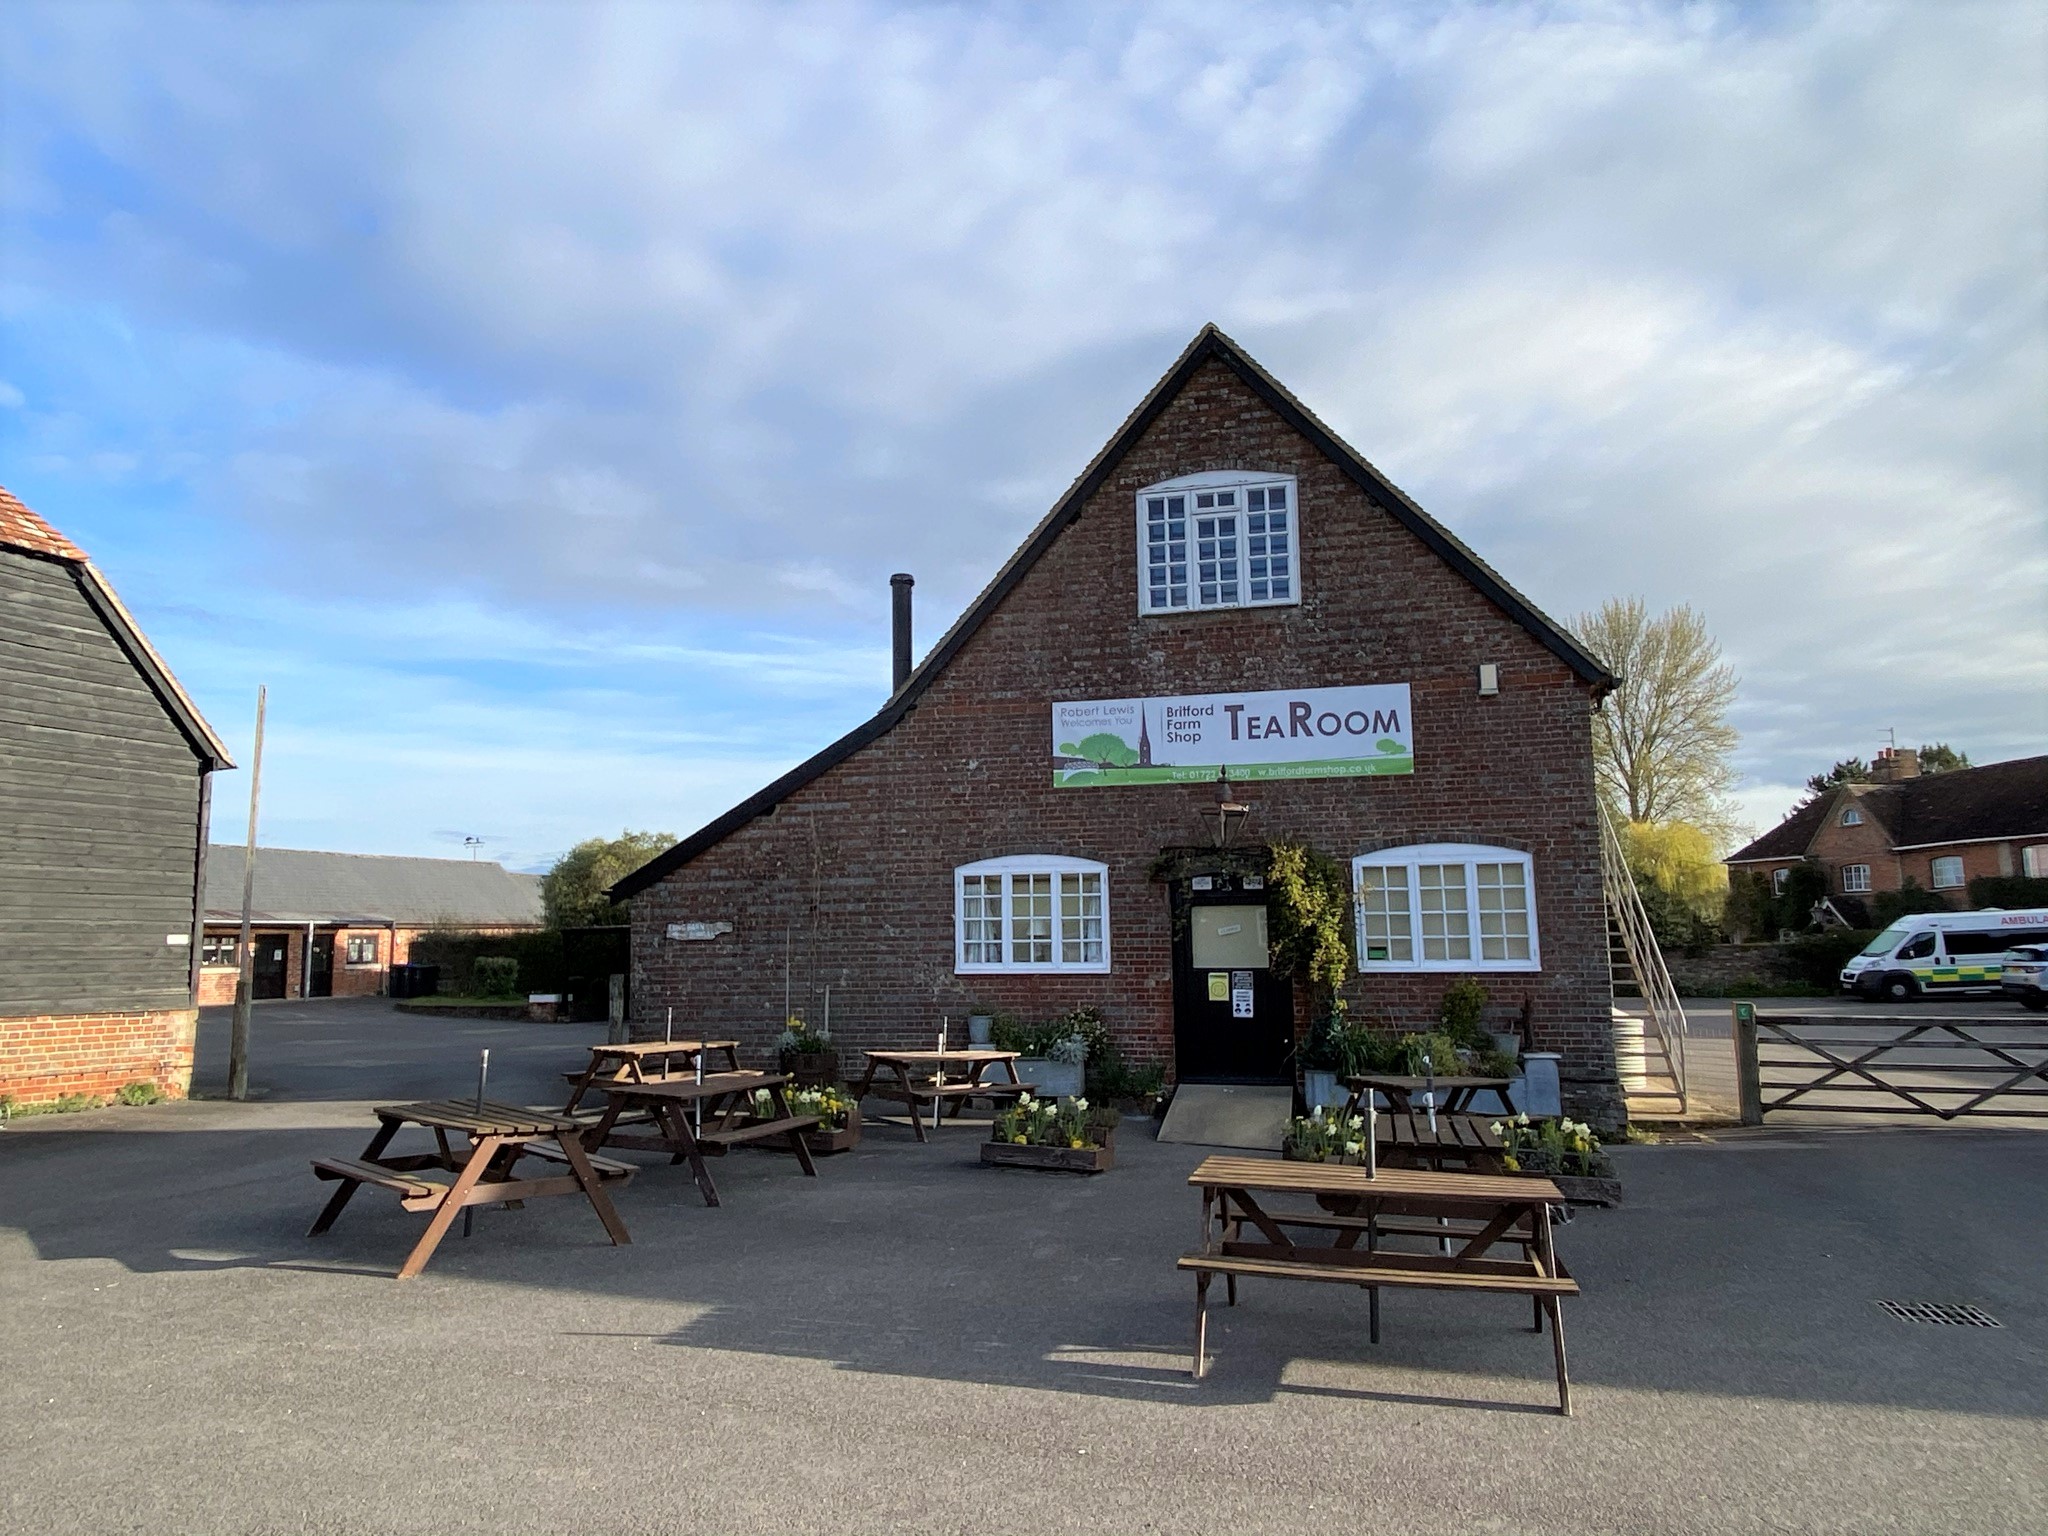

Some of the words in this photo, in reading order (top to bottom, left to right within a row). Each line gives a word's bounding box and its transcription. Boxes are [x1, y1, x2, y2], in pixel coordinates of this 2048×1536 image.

[1060, 706, 1100, 717] Robert
[1103, 705, 1135, 716] Lewis
[1166, 704, 1214, 718] Britford
[1061, 718, 1112, 728] Welcomes
[1115, 716, 1133, 725] You
[1167, 719, 1201, 730] Farm
[1167, 731, 1202, 744] Shop
